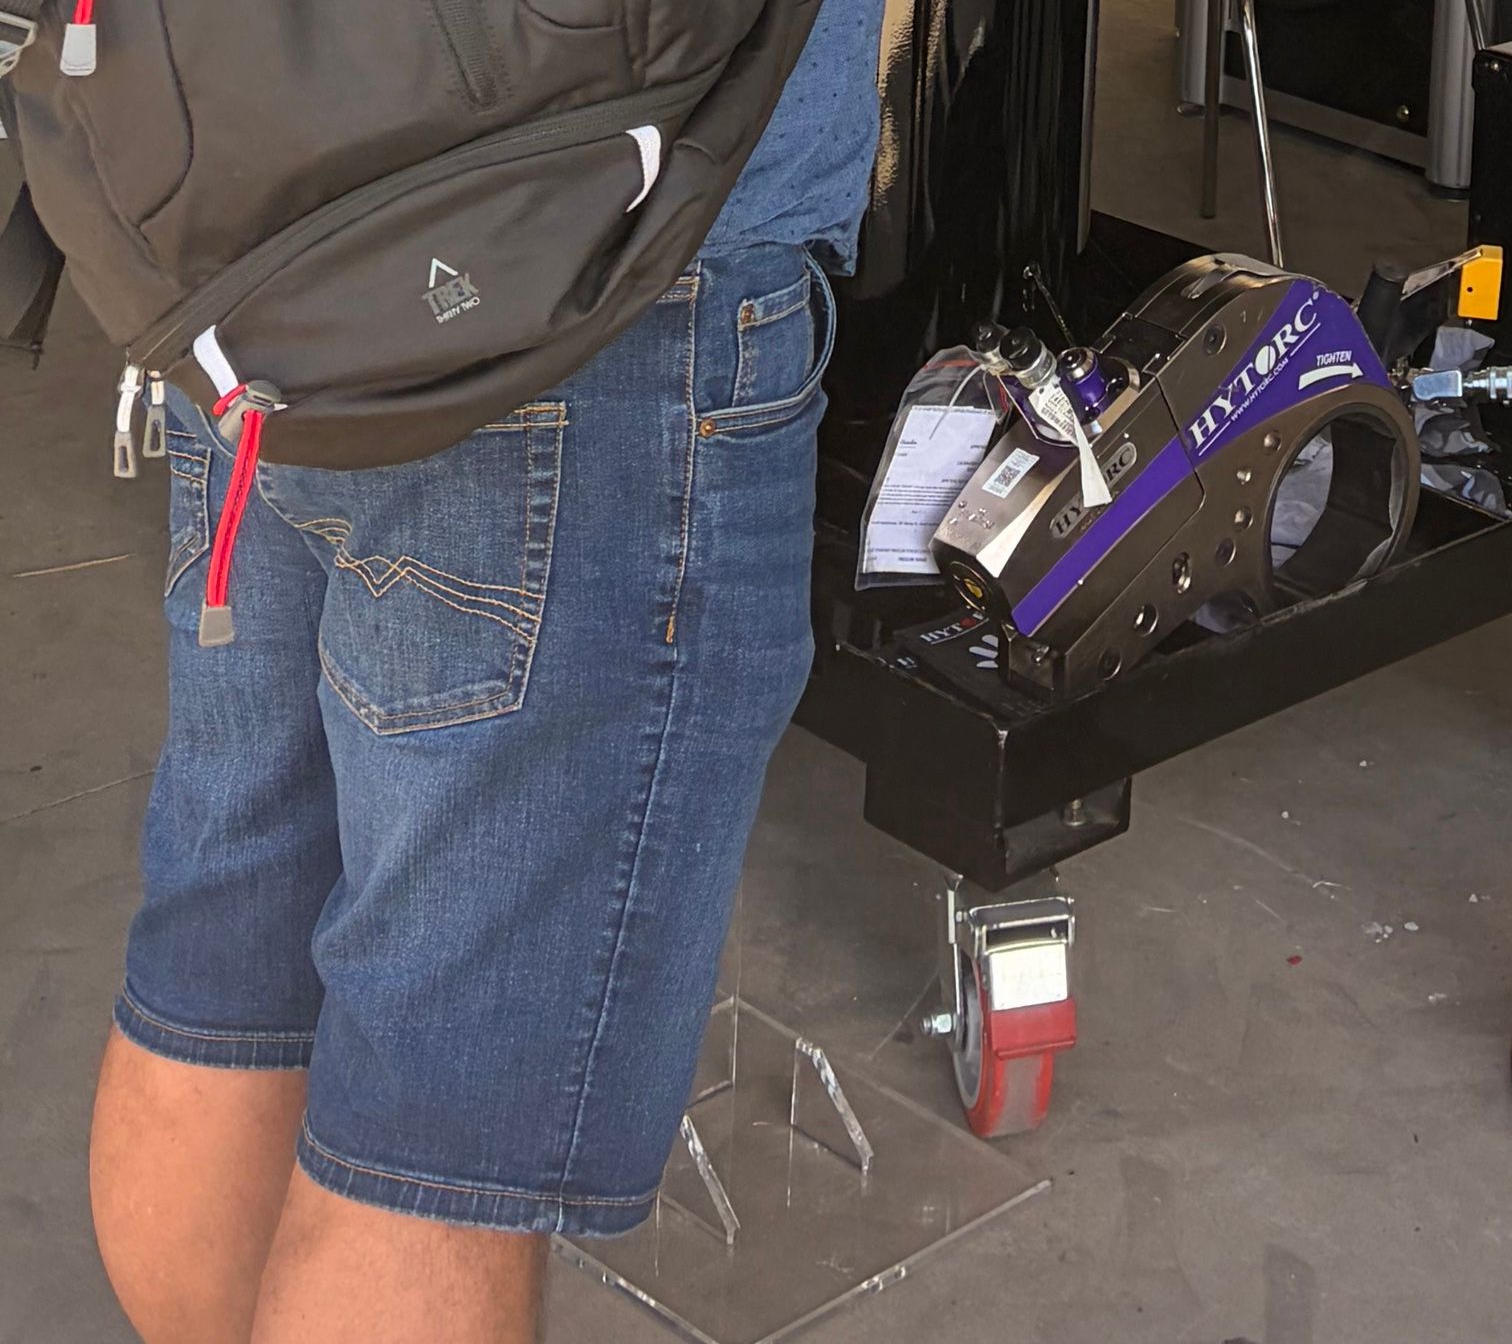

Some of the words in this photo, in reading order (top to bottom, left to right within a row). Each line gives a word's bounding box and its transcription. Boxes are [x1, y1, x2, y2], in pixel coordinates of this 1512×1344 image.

[1187, 299, 1318, 449] HYTORC
[1315, 350, 1353, 367] TIGHTEN
[1055, 449, 1134, 534] HYRC
